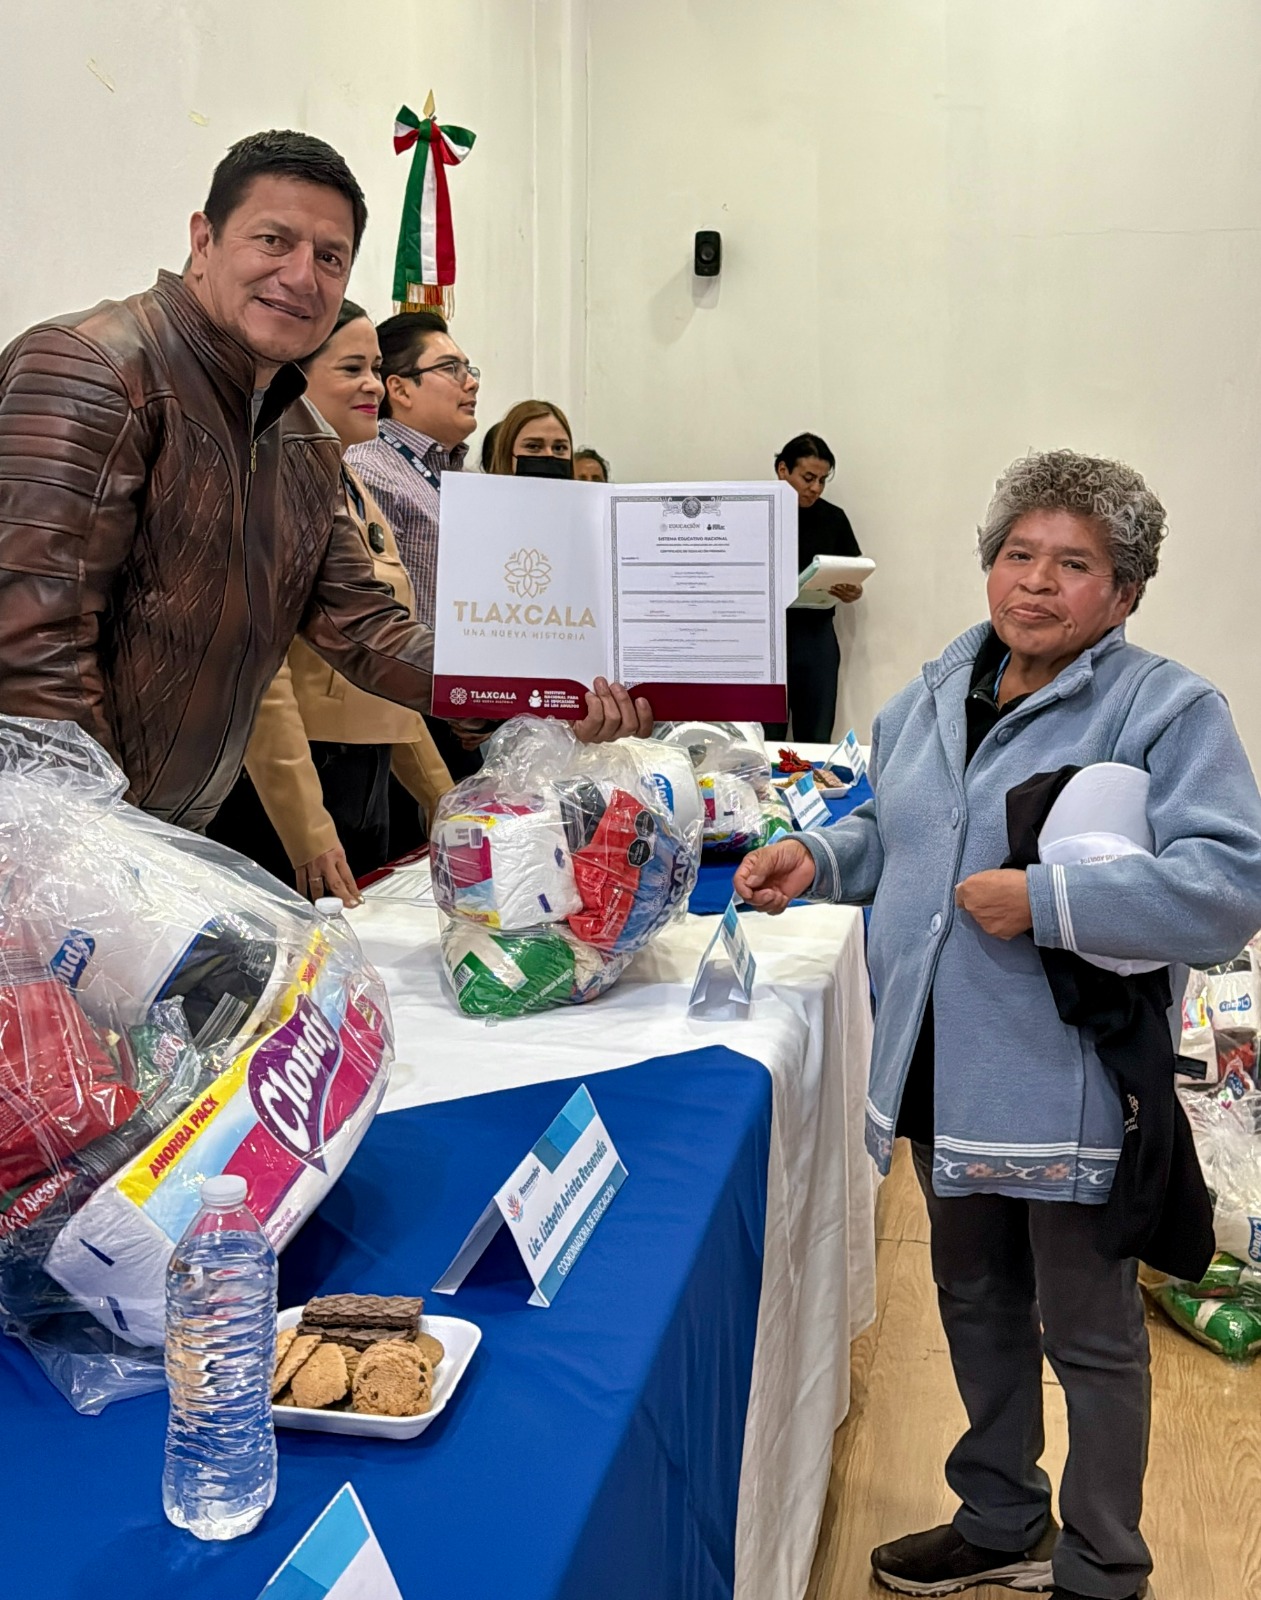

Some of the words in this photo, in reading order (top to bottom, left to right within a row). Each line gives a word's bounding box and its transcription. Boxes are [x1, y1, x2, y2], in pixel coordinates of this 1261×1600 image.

[453, 600, 596, 628] TLAXCALA
[464, 628, 486, 637] UNA
[491, 630, 527, 638] NUEVA
[532, 631, 586, 641] HISTORIA
[470, 690, 517, 700] TLAXCALA
[260, 1013, 337, 1153] Cloudy
[149, 1124, 192, 1178] AHORRA
[190, 1095, 219, 1131] PACK
[528, 1236, 544, 1260] Lic.
[538, 1200, 565, 1242] Lizbeth
[560, 1177, 583, 1210] Arista
[556, 1221, 591, 1276] COORDINADORA
[586, 1214, 596, 1230] DE
[591, 1183, 616, 1222] EDUCACIÓN
